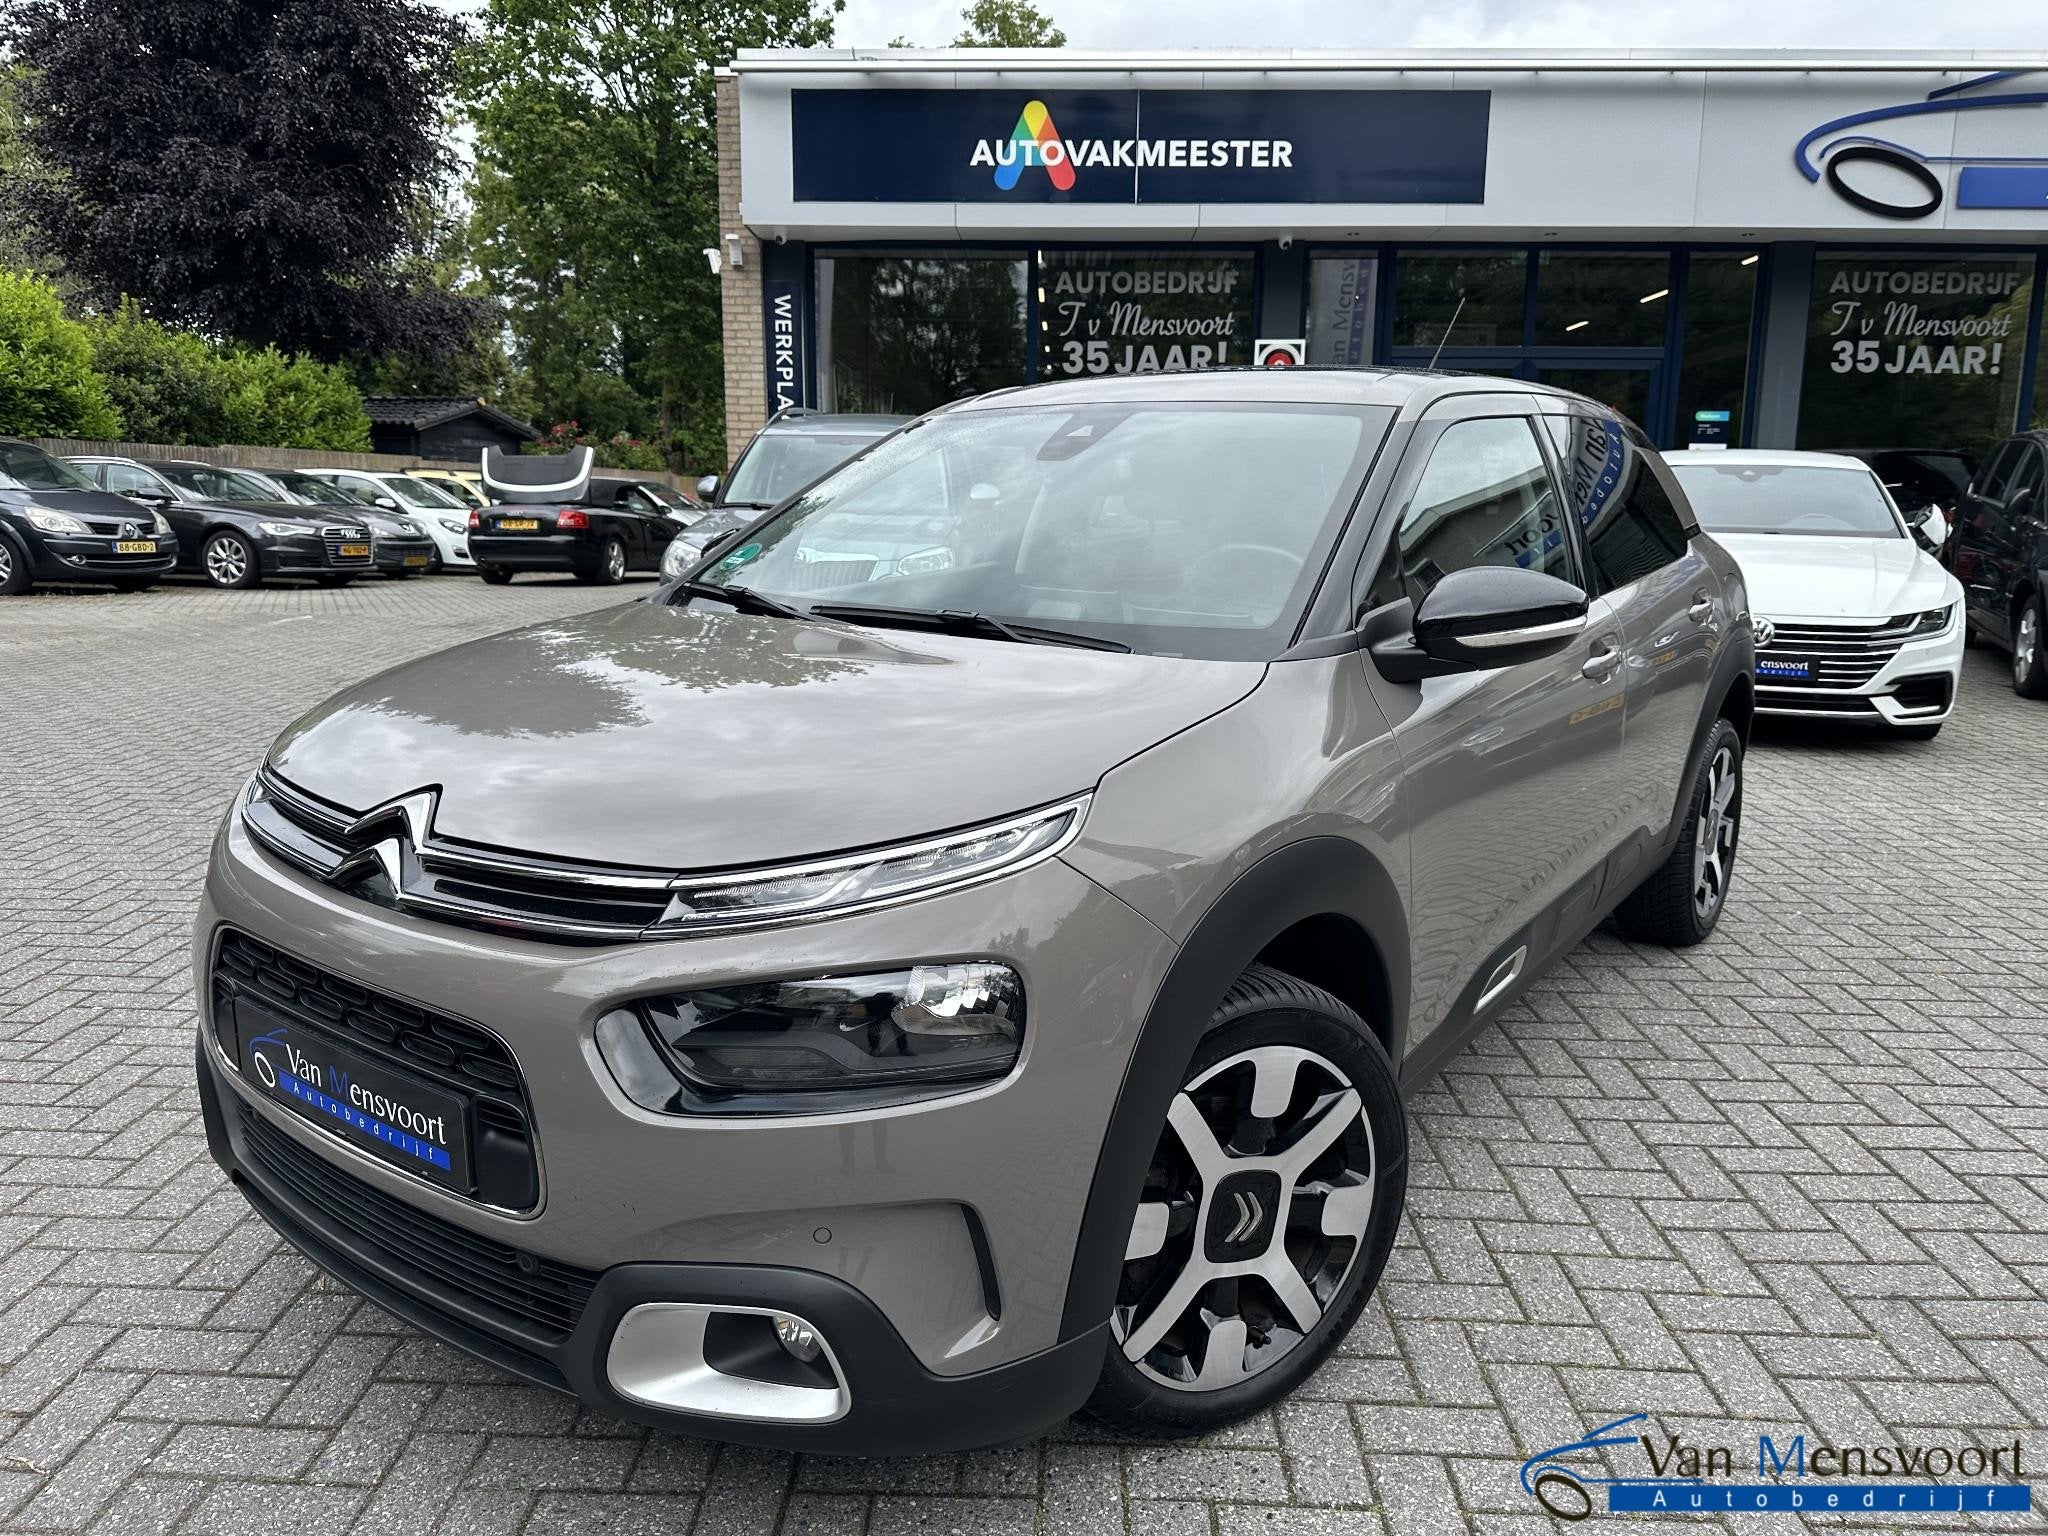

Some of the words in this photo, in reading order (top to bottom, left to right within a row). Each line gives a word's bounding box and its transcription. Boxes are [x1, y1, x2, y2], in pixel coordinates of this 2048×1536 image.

[969, 139, 1293, 168] AUTOVAKMEESTER
[1054, 271, 1240, 294] AUTOBEDRIJF
[1829, 271, 2021, 295] AUTOBEDRIJF
[1109, 300, 1235, 337] Mensvoort
[1883, 300, 2012, 337] Mensvoort
[774, 294, 794, 420] WERKPLA
[1062, 341, 1110, 374] 35
[1114, 341, 1228, 374] JAAR!
[1830, 340, 1880, 374] 35
[1884, 343, 2003, 375] JAAR!
[285, 1043, 322, 1087] Van
[328, 1065, 448, 1145] Mensvoort
[293, 1081, 434, 1161] Autobedrijf
